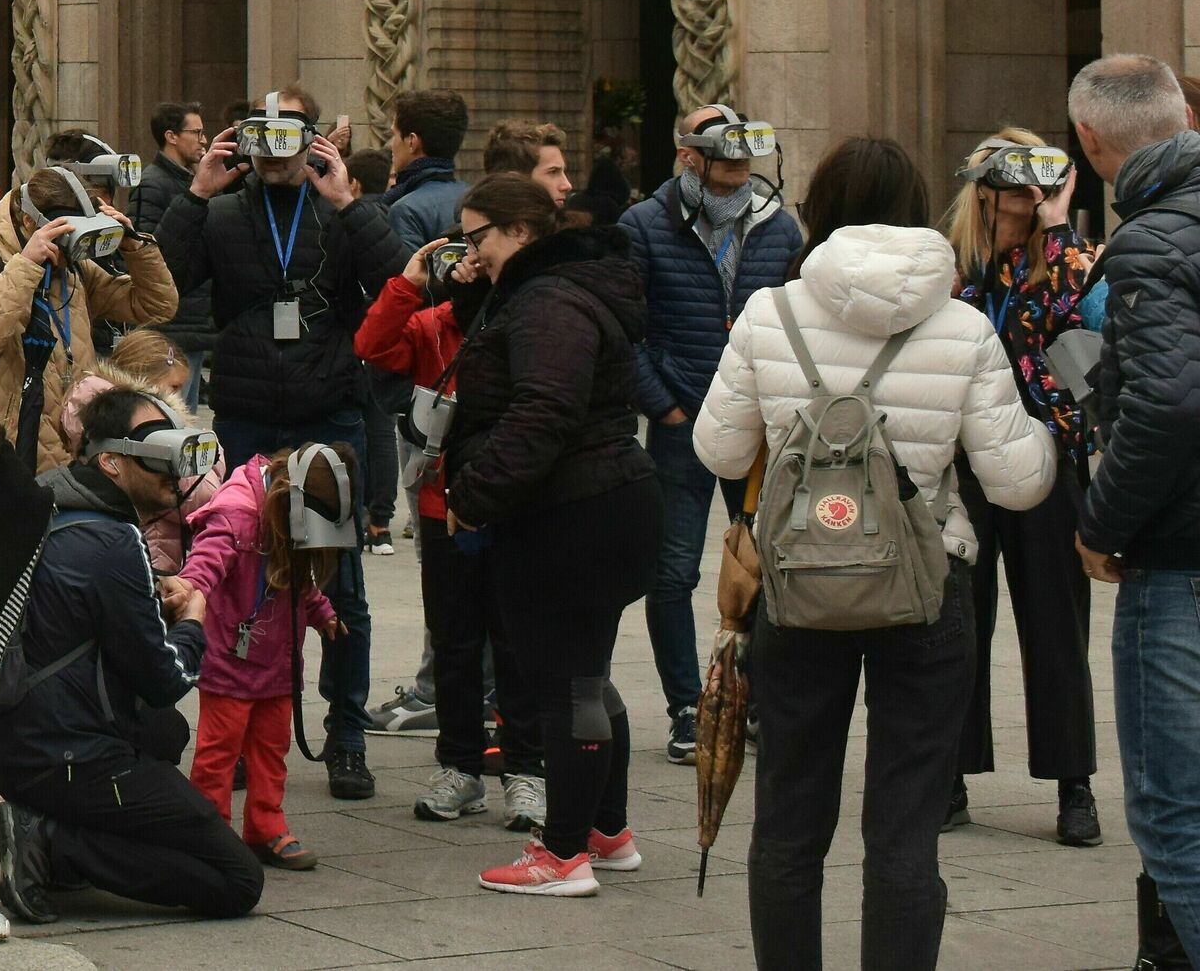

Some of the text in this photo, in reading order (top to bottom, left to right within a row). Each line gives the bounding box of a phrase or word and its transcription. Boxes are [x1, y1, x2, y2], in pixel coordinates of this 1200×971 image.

[274, 128, 288, 137] YOU
[1040, 155, 1054, 163] YOU
[1041, 170, 1055, 178] LEO
